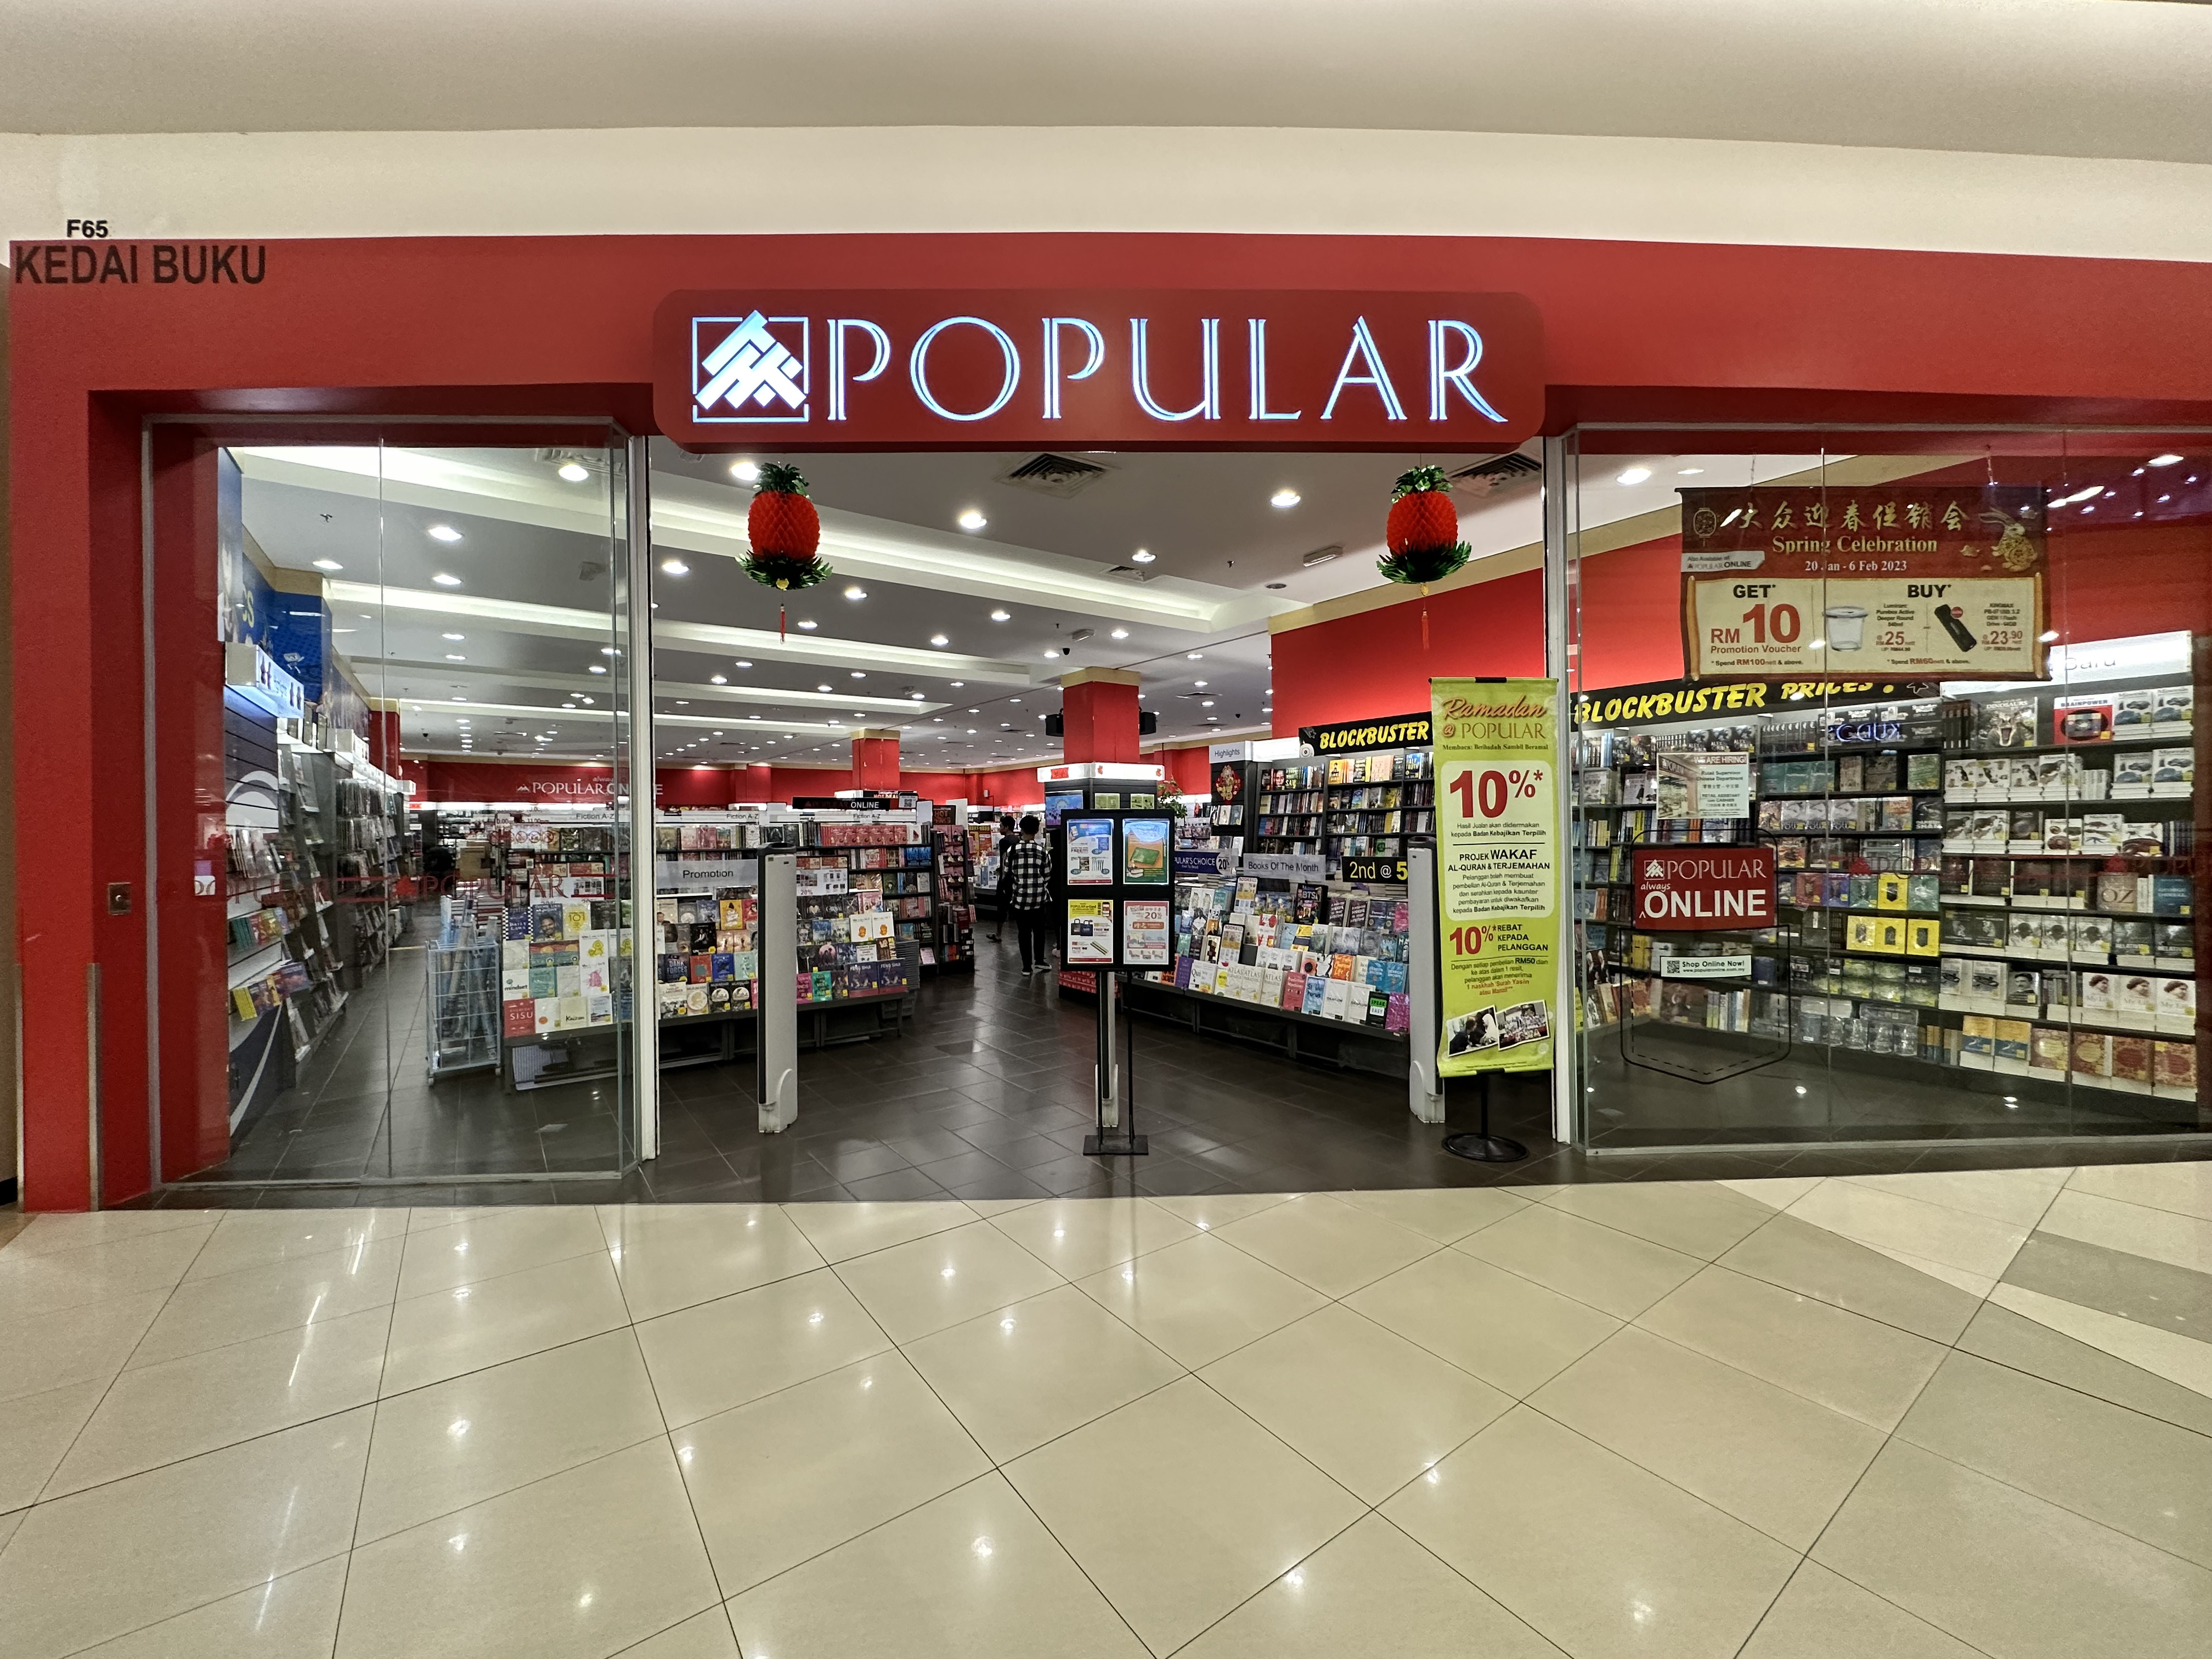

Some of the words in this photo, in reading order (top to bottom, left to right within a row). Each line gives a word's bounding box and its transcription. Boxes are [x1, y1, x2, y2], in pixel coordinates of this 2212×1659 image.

[66, 219, 109, 239] F65
[15, 245, 138, 284] KEDAI
[153, 245, 266, 284] BUKU
[827, 315, 1509, 422] POPULAR
[1773, 535, 1831, 556] Spring
[1837, 535, 1938, 553] Celebration
[1804, 560, 1818, 572] 20
[1849, 561, 1856, 572] 6
[1859, 561, 1878, 572] Feb
[1881, 560, 1907, 572] 2023
[1711, 628, 1740, 644] RM
[1742, 603, 1801, 644] 10
[1884, 631, 1905, 645] 25
[1710, 645, 1759, 654] Promotion
[1762, 645, 1802, 653] Voucher
[1442, 694, 1547, 720] Ramadan
[1575, 684, 1767, 724] BLOCKBUSTER
[1986, 700, 2028, 709] DINOSAURS
[1319, 720, 1430, 750] BLOCKBUSTER
[1443, 724, 1455, 738] @
[1462, 722, 1546, 739] POPULAR
[1214, 749, 1240, 758] Highlights
[532, 782, 603, 795] POPULAR
[1459, 853, 1489, 861] PROJEK
[1490, 849, 1537, 860] WAKAF
[1193, 857, 1216, 866] CHOICE
[1248, 861, 1269, 870] Books
[1271, 862, 1279, 870] Of
[1280, 862, 1294, 871] The
[1295, 861, 1319, 872] Month
[1448, 863, 1486, 872] AL-QURAN
[682, 868, 734, 879] Promotion
[1349, 861, 1375, 880] 2nd
[1380, 862, 1393, 878] @
[1667, 859, 1767, 880] POPULAR
[422, 874, 569, 900] POPULAR
[1453, 882, 1480, 890] pembelian
[1640, 881, 1671, 893] always
[1302, 890, 1317, 900] BTS
[2101, 888, 2135, 904] OZ
[1644, 889, 1767, 919] ONLINE
[1453, 906, 1472, 915] kepada
[568, 913, 585, 922] 101
[667, 966, 688, 974] FORCES
[1681, 961, 1700, 969] Shop
[1244, 969, 1261, 979] ATLAS
[1264, 973, 1282, 982] ATLAS
